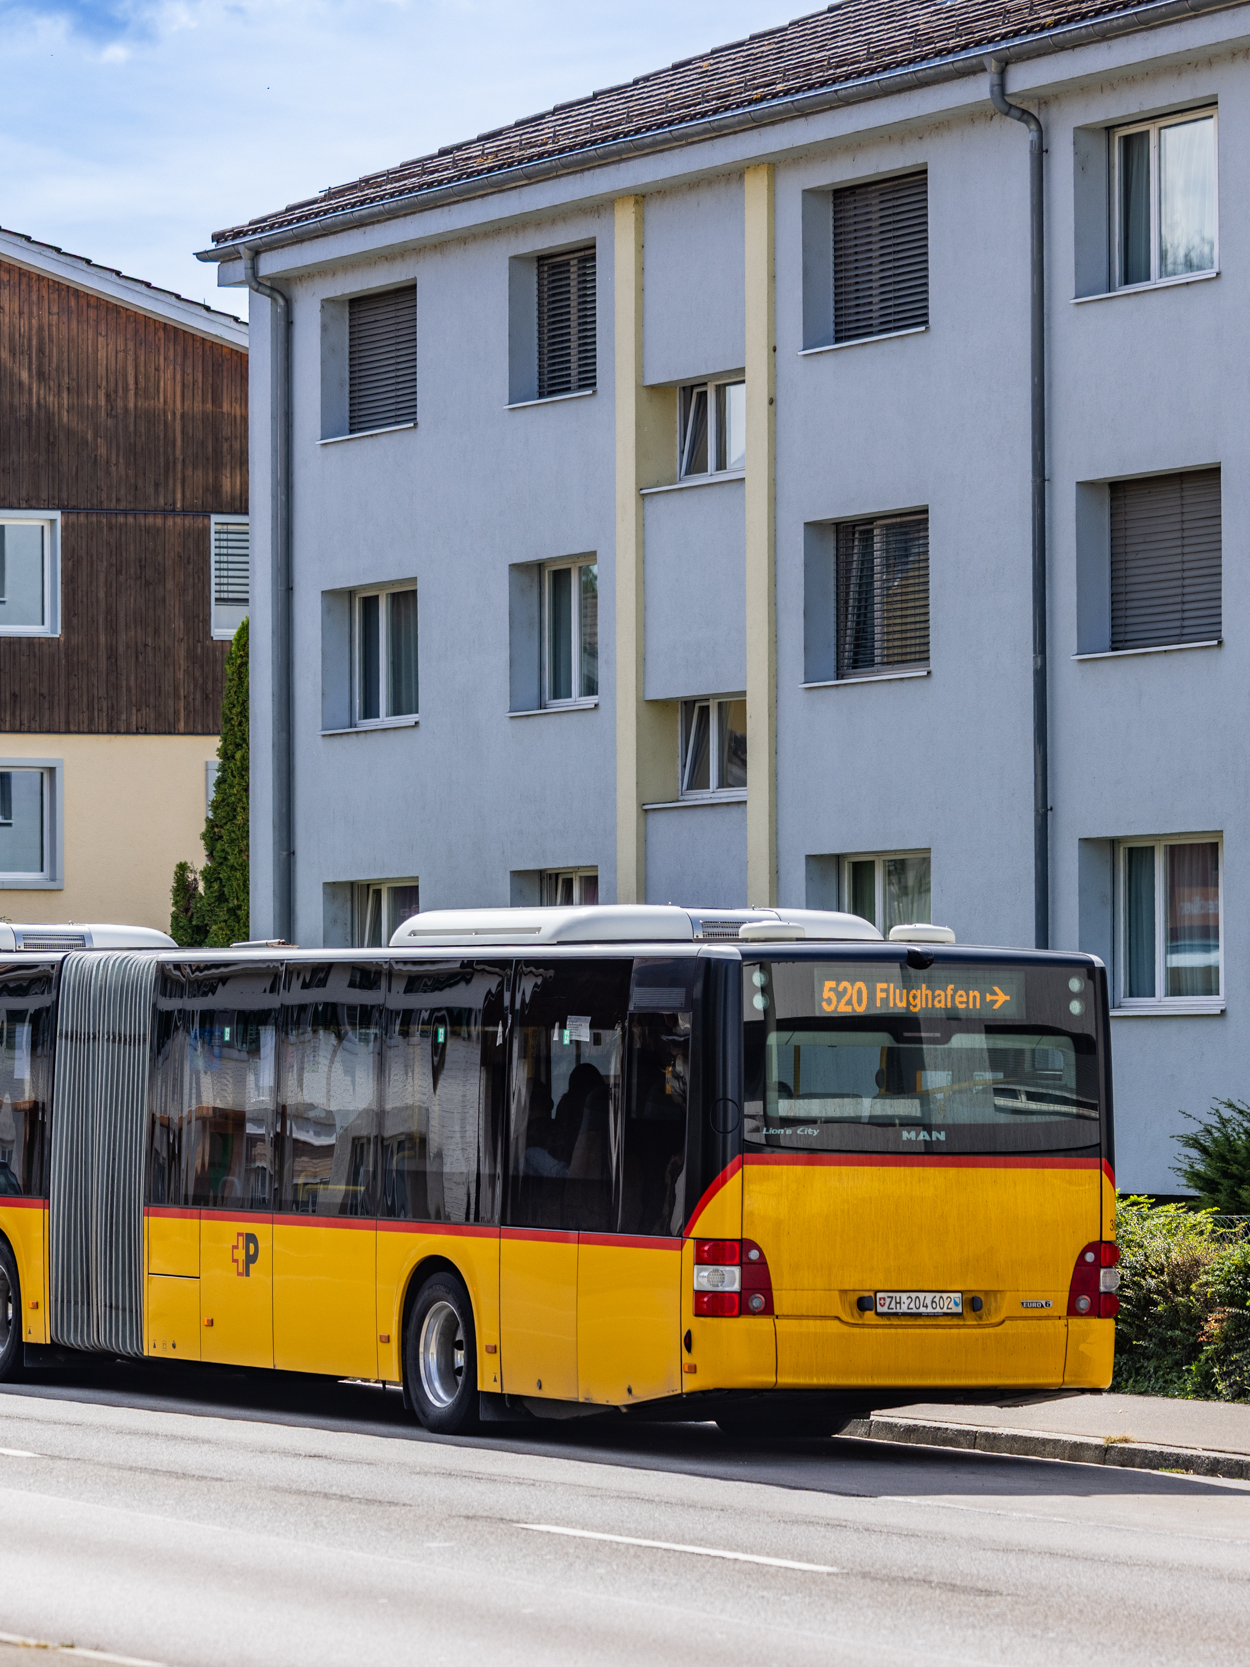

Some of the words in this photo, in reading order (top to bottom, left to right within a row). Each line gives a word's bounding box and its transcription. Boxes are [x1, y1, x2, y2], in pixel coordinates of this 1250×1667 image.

[821, 980, 868, 1013] 520
[876, 983, 981, 1012] Flughafen
[762, 1127, 793, 1135] Lion's
[797, 1127, 820, 1137] City
[902, 1130, 946, 1141] MAN
